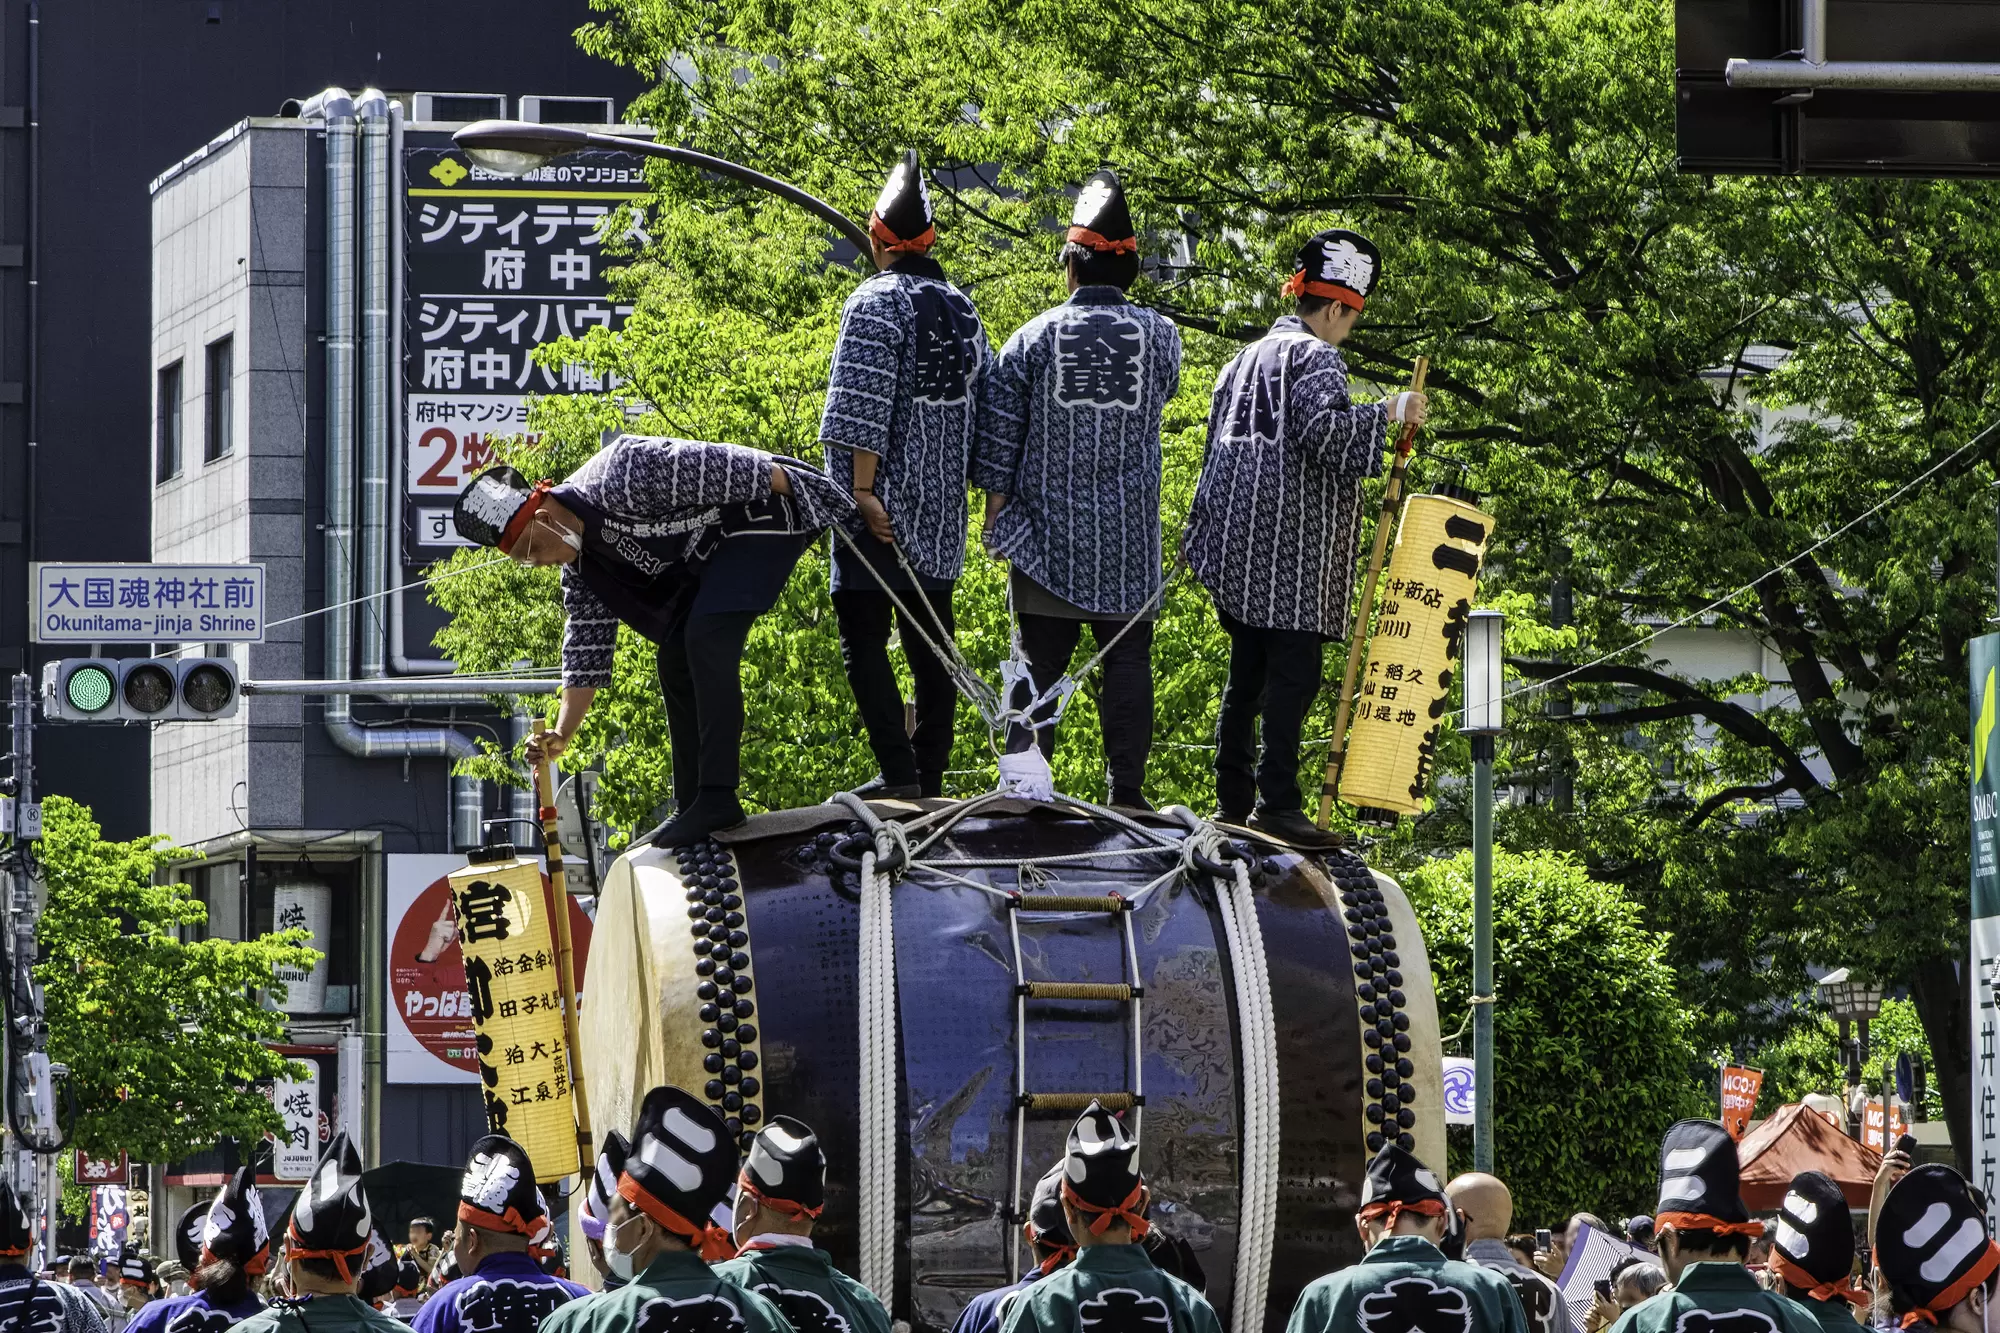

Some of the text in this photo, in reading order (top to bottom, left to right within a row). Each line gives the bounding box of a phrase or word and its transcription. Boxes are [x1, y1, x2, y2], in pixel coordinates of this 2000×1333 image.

[482, 249, 590, 290] 府中
[422, 348, 625, 391] 府中八幡
[48, 576, 255, 609] 大国魂神社前
[47, 614, 256, 634] Okunitama-jinja Shrine
[1973, 791, 1998, 822] SMBC
[284, 1090, 313, 1150] 焼肉
